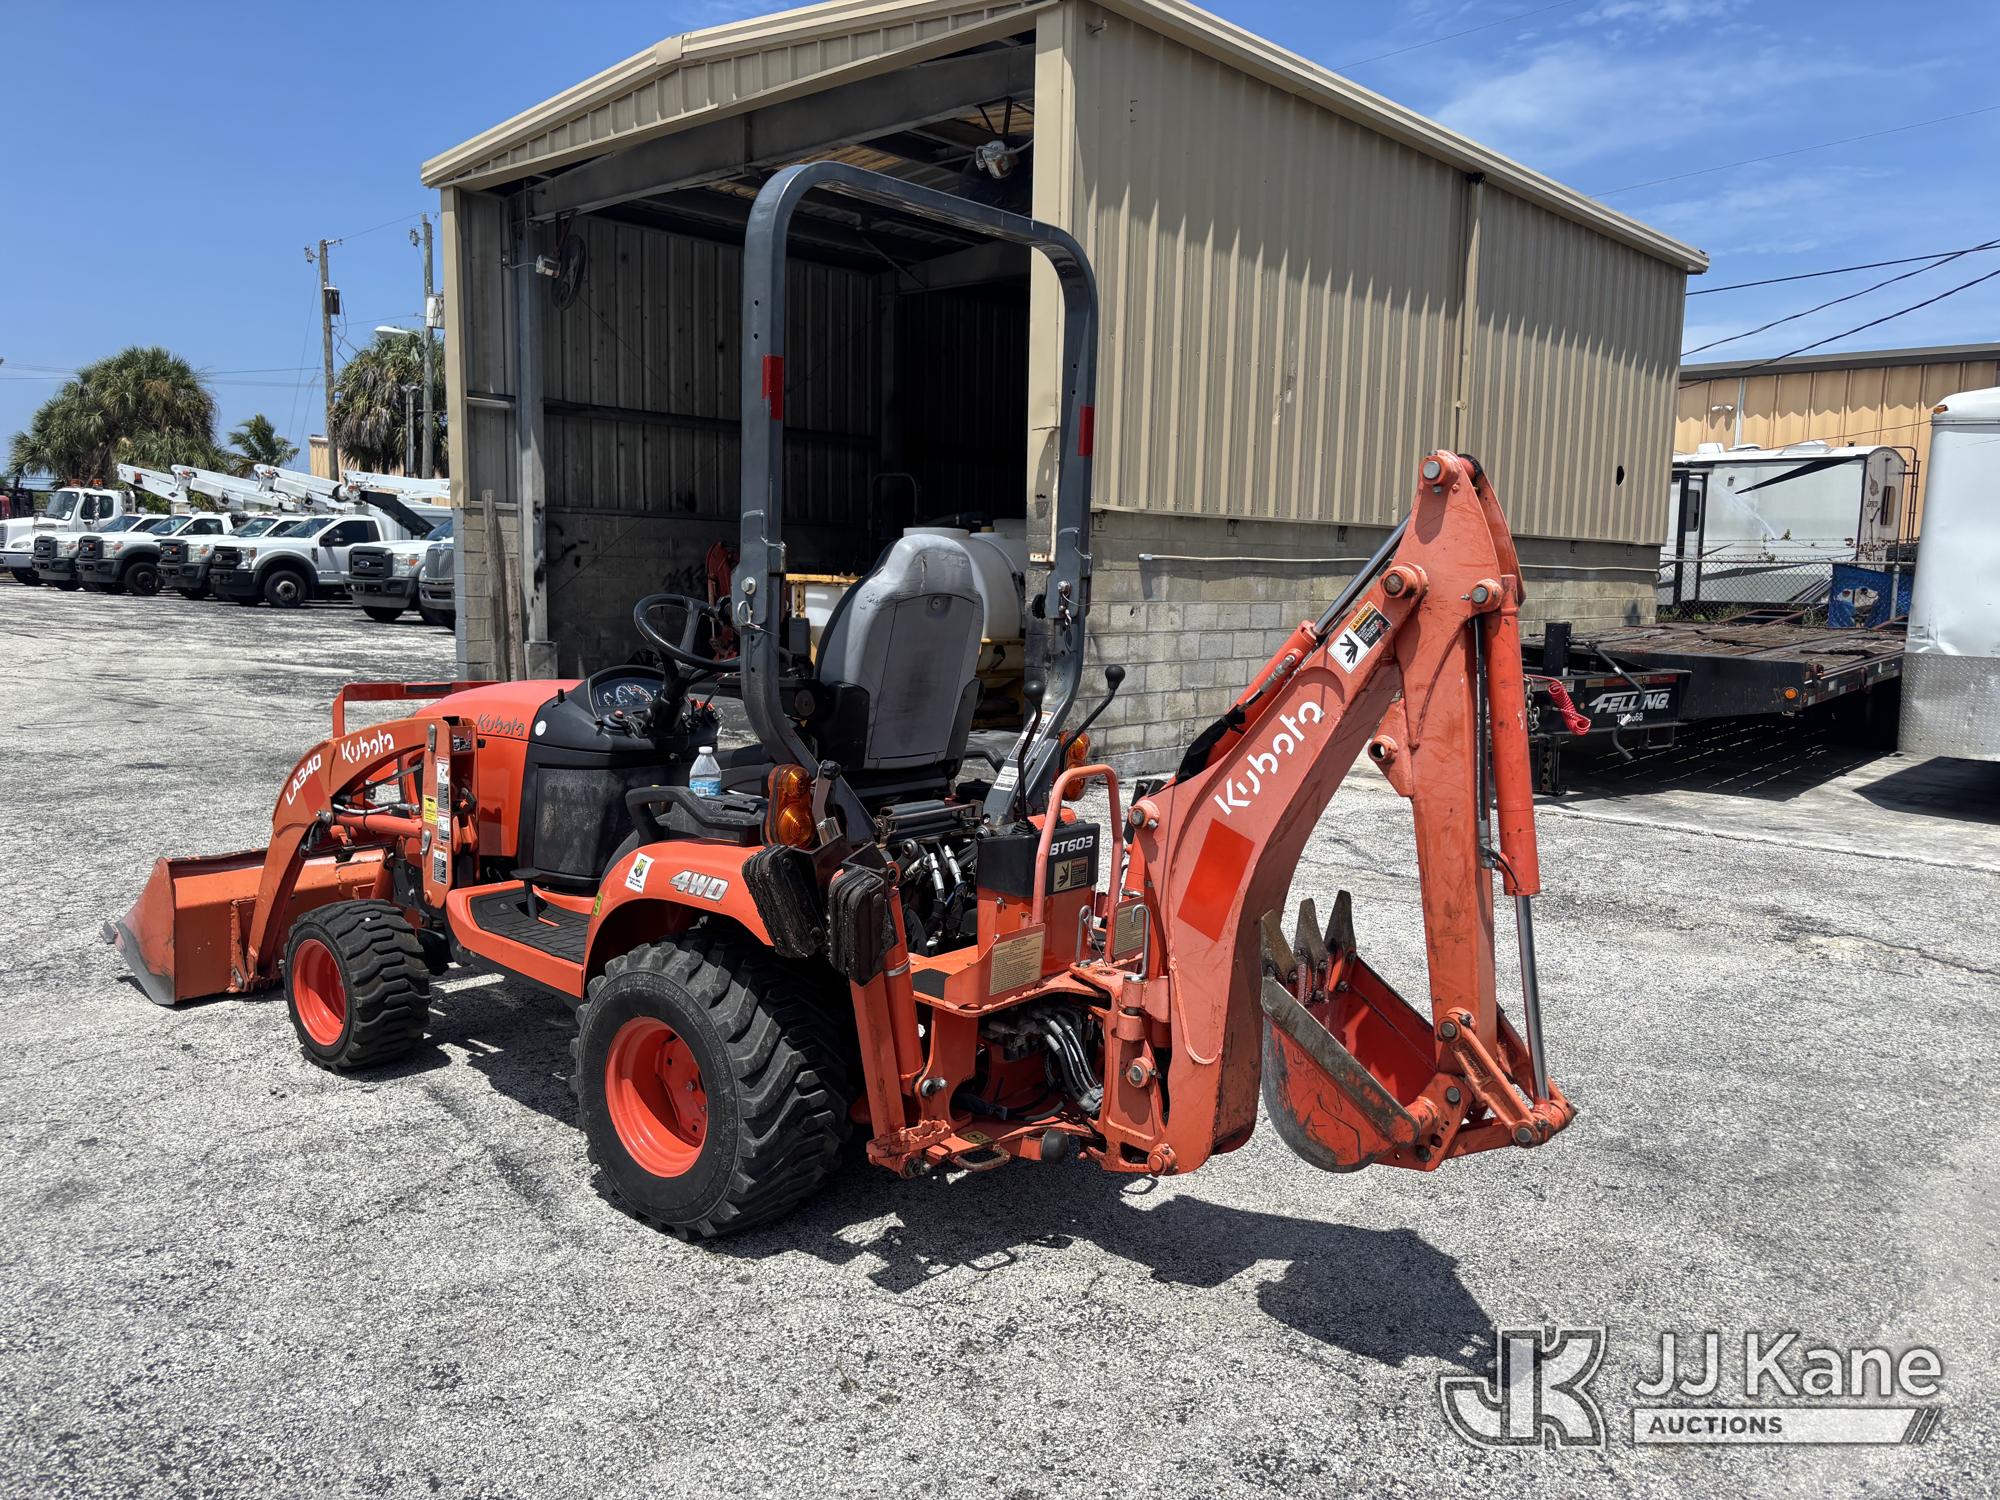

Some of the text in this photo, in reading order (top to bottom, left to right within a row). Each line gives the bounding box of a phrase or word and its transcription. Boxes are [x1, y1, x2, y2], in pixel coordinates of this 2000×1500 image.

[1589, 688, 1671, 713] FELLNG.
[476, 713, 526, 737] Kubota
[340, 729, 394, 764] Kubota
[1213, 701, 1326, 816] Kubota
[285, 754, 322, 806] LA340
[1049, 835, 1094, 856] BT603
[669, 869, 730, 902] 4WD
